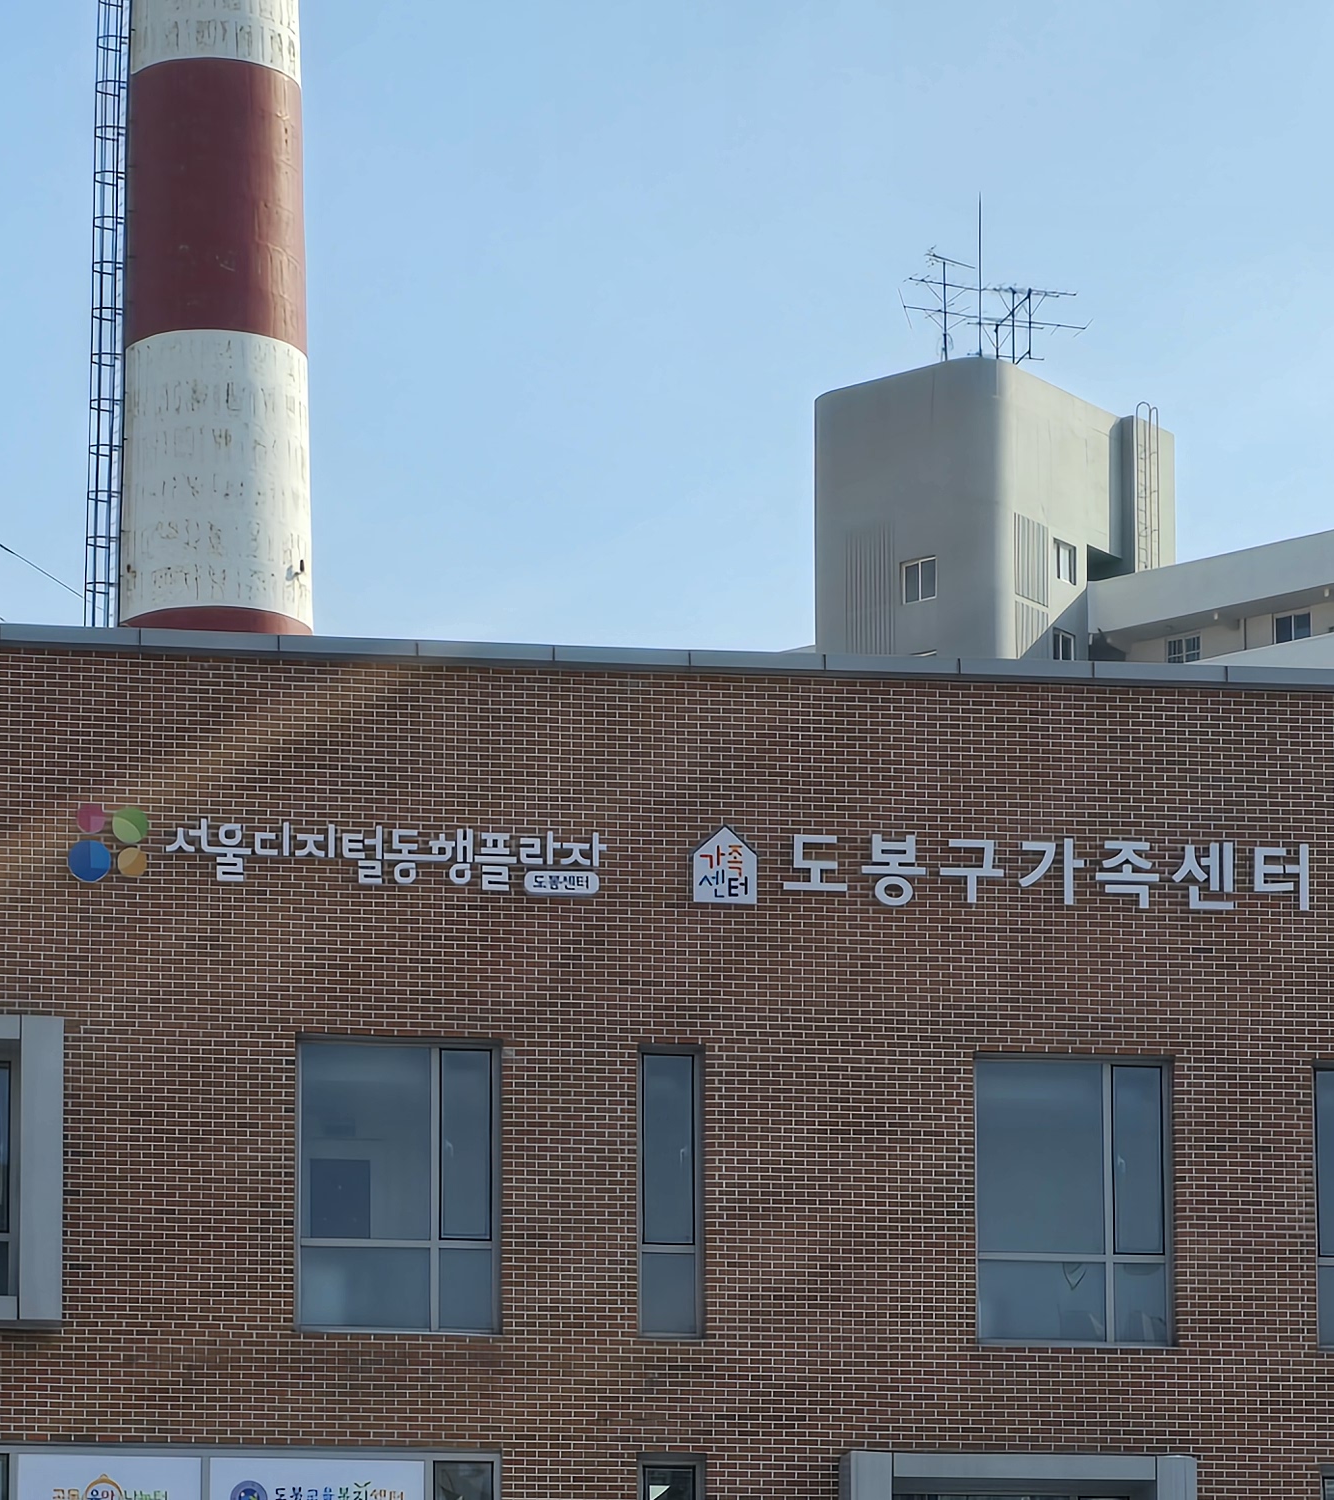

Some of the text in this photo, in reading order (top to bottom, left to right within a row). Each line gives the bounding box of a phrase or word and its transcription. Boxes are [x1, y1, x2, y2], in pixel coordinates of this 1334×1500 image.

[165, 816, 608, 892] 서울디지털동행플라자
[699, 844, 744, 878] 가족
[532, 874, 590, 891] 도봉센터
[698, 868, 749, 899] 센터
[783, 834, 1310, 911] 도봉구가족센터
